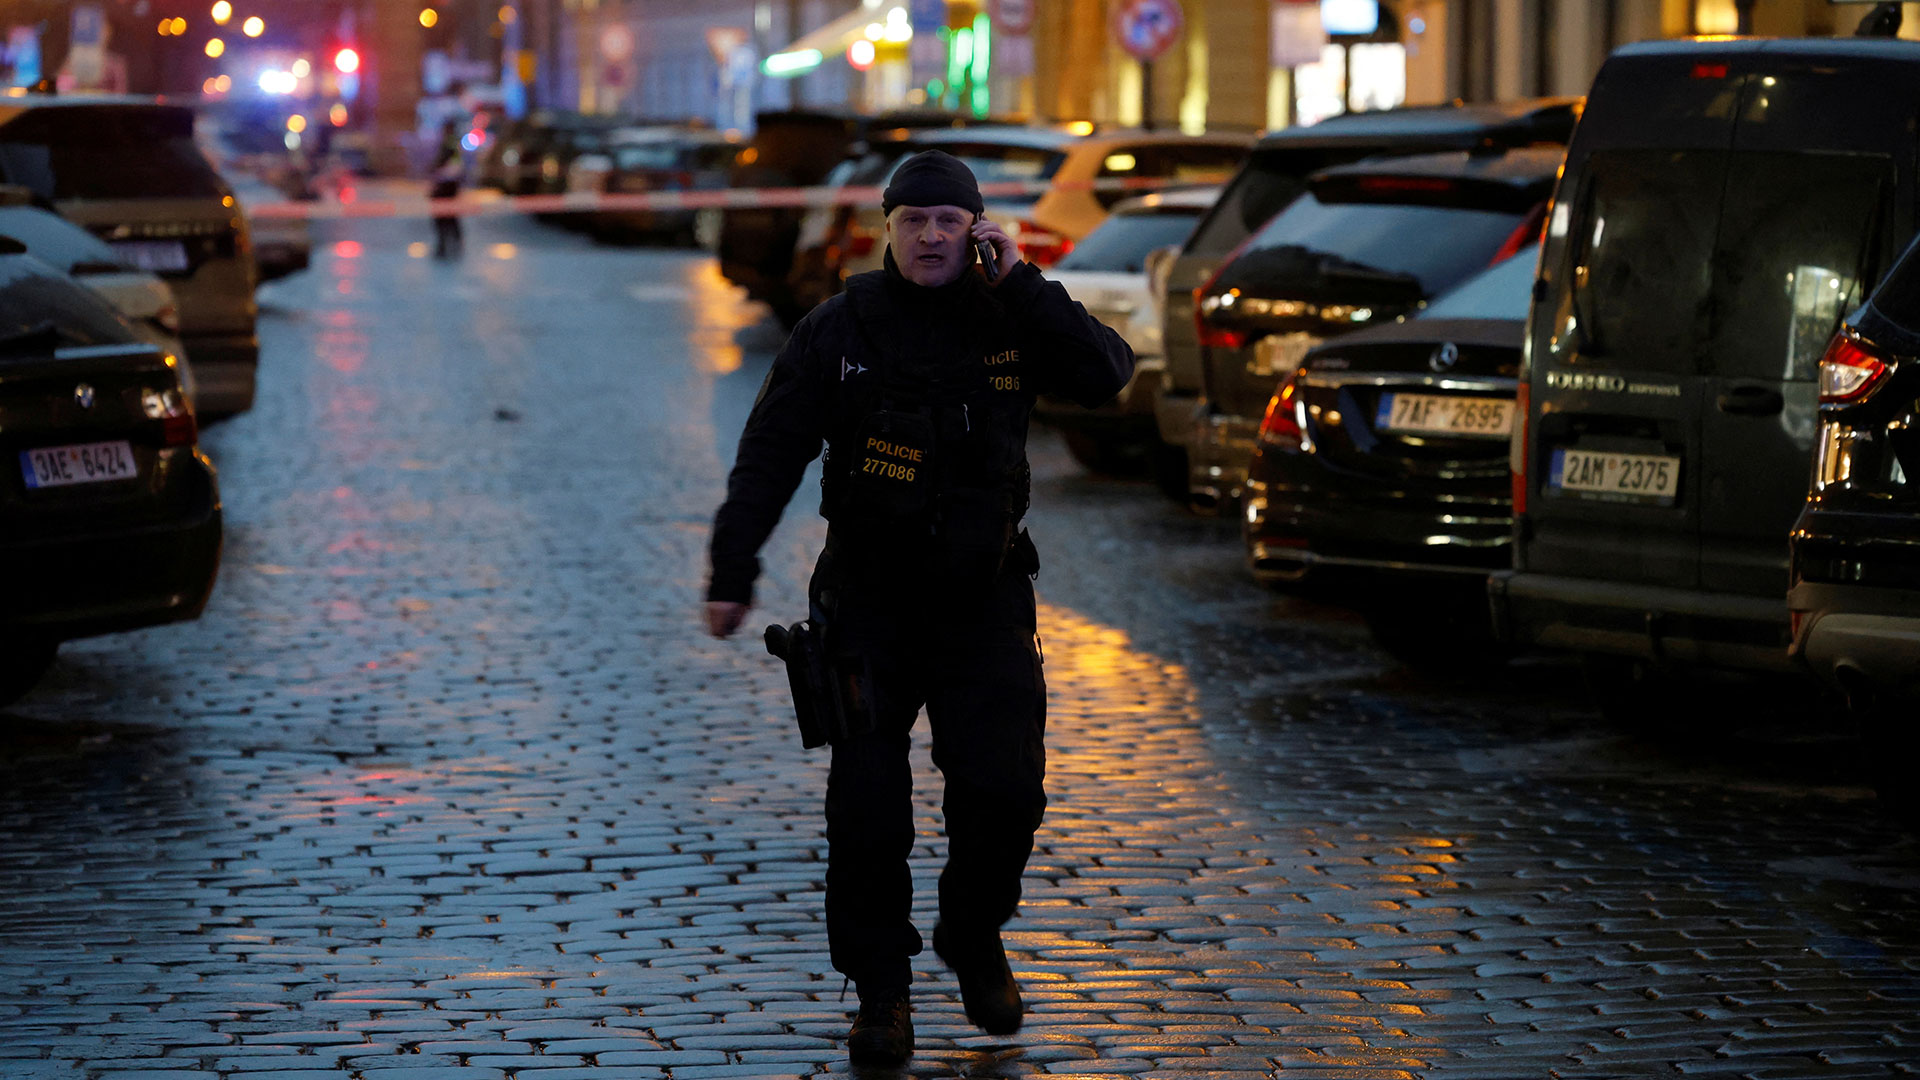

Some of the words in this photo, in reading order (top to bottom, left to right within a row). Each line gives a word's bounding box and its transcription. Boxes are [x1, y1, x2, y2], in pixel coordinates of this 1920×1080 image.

[984, 350, 1020, 366] LICIE
[1395, 399, 1436, 425] 7AF
[1451, 402, 1506, 429] 2695
[35, 451, 73, 481] 3AE
[82, 446, 127, 478] 6424
[866, 437, 924, 463] POLICIE
[862, 457, 916, 482] 277086
[1566, 456, 1605, 486] 2AM
[1618, 460, 1670, 491] 2375
